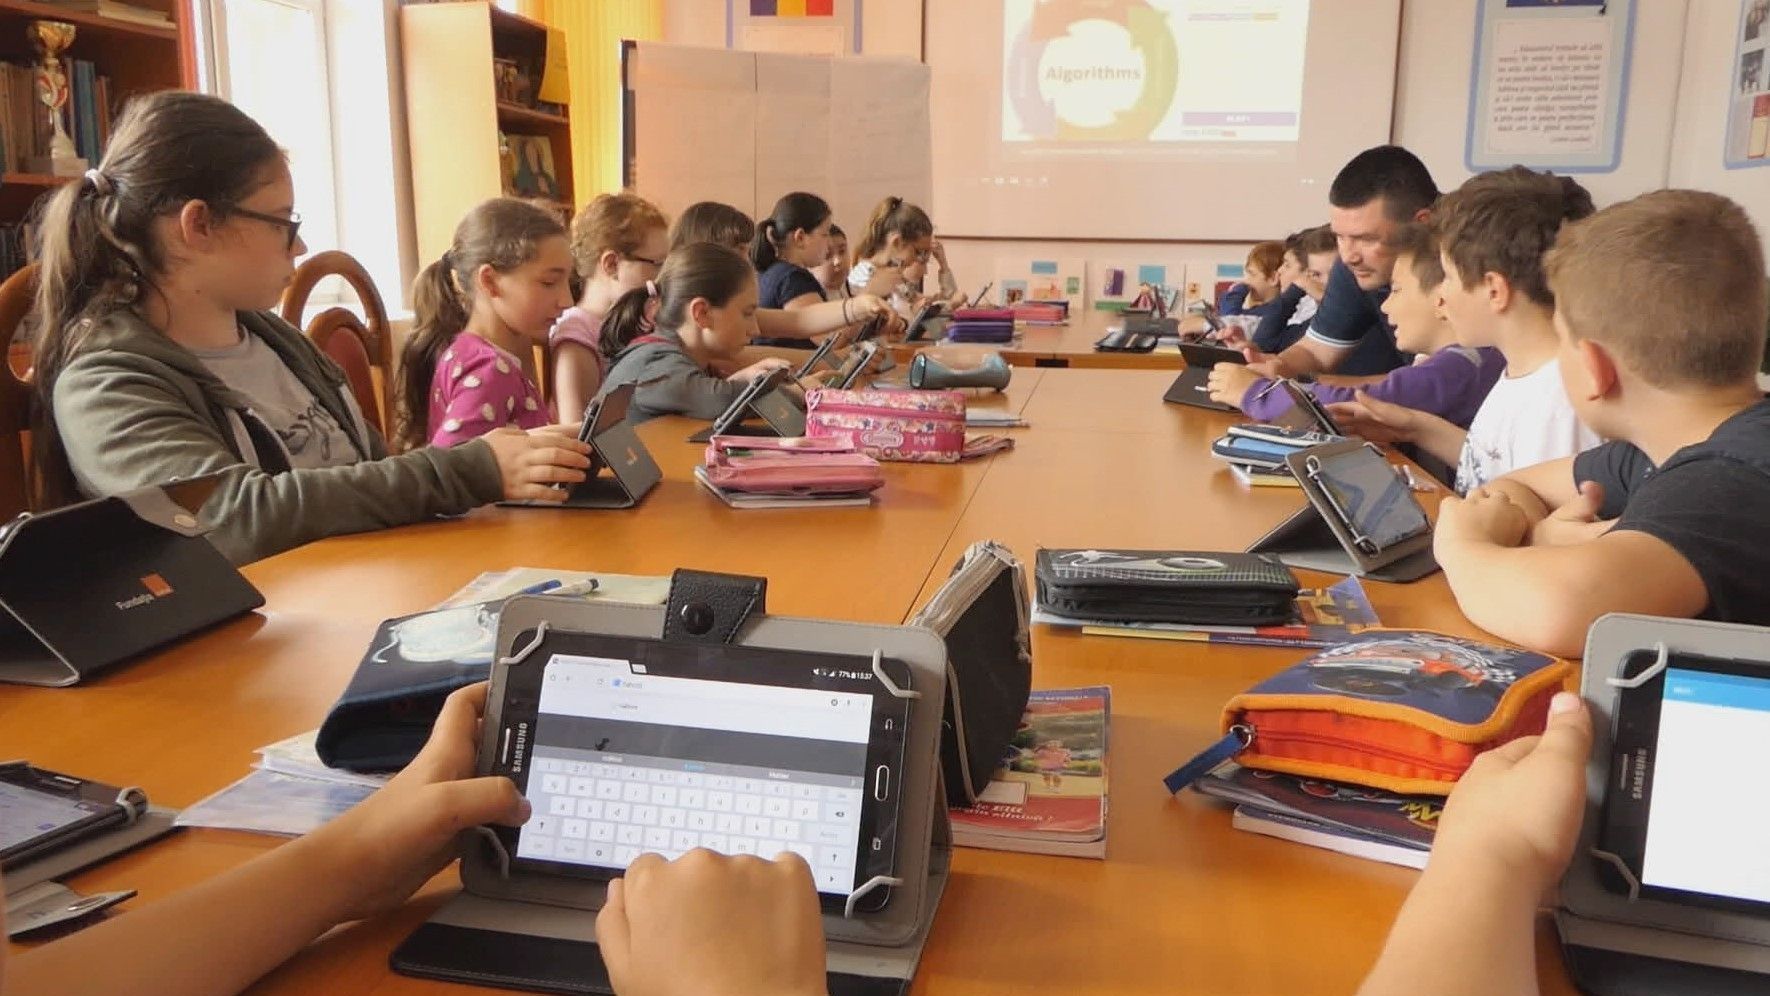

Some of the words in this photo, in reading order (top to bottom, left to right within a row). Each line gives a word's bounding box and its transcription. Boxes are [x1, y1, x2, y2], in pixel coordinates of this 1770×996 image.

[1045, 65, 1141, 83] Algorithms
[512, 722, 528, 773] SAMSUNG
[1631, 747, 1648, 801] SAMSUNG
